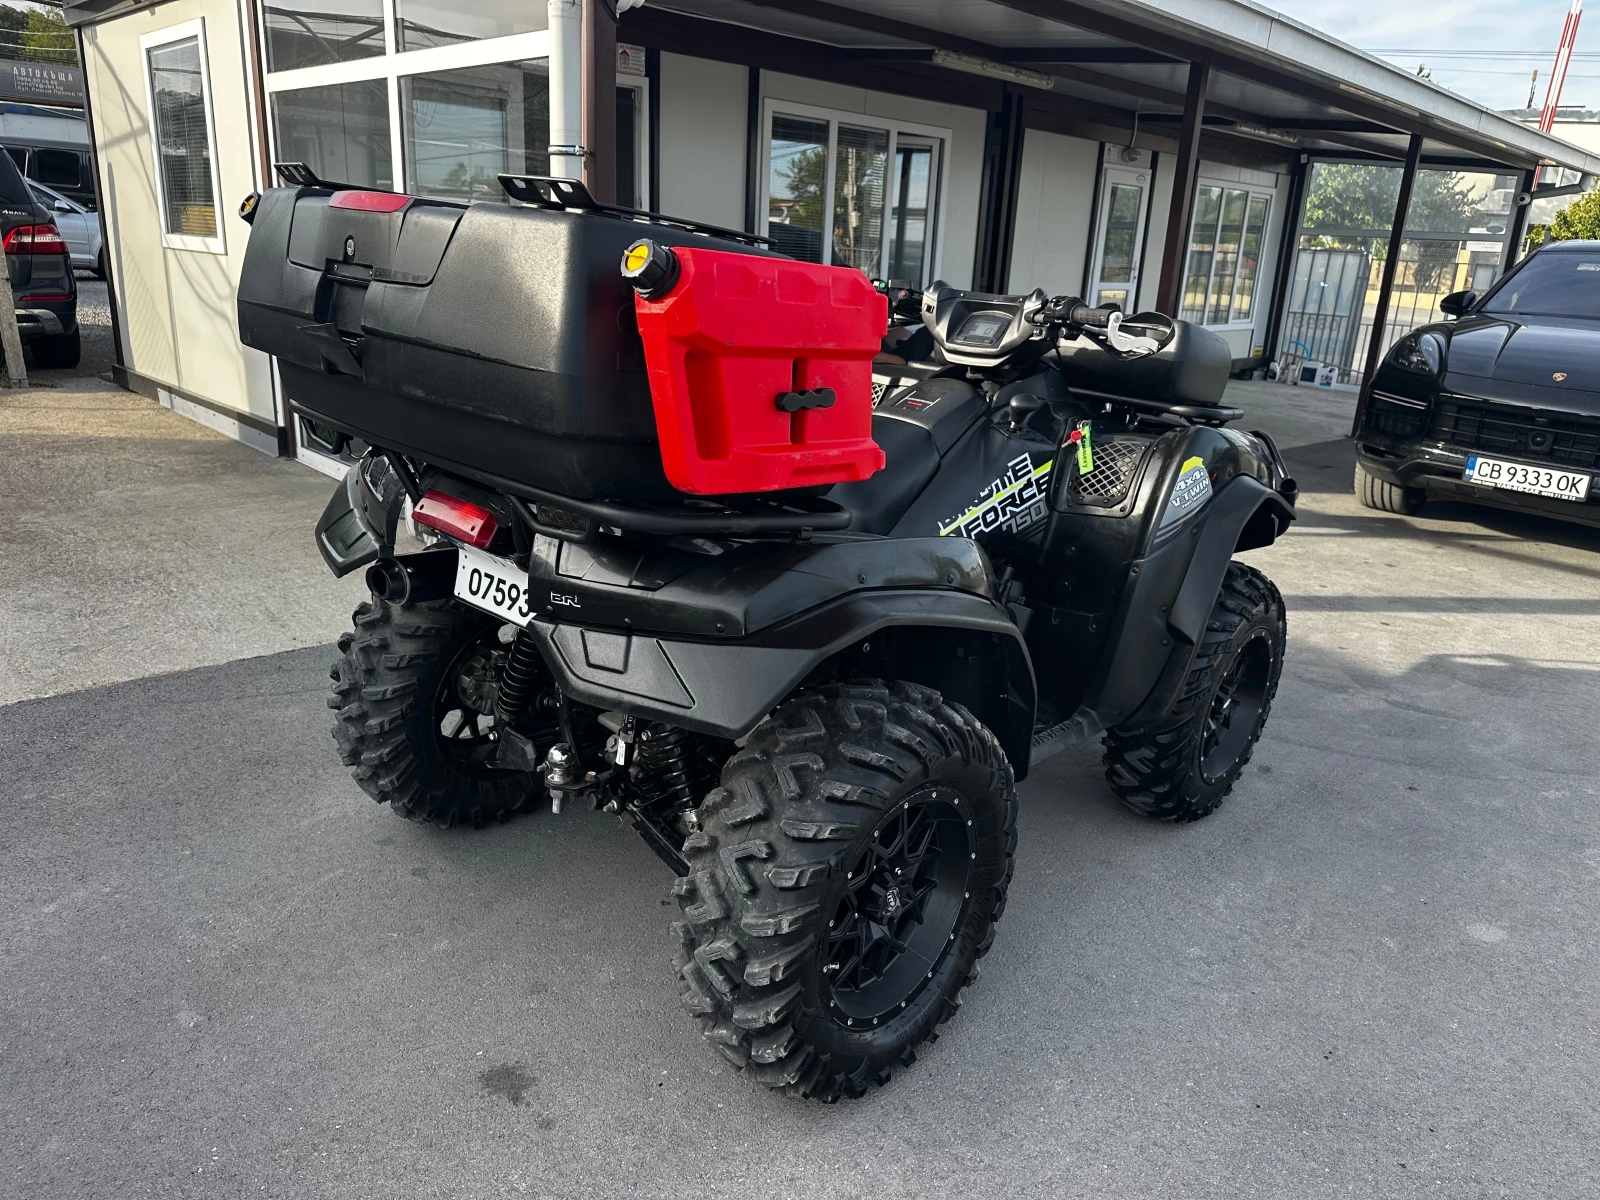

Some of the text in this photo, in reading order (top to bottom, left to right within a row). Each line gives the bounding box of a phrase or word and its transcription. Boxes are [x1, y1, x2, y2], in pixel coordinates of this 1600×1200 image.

[13, 66, 73, 82] АВТОКЪЩА
[1170, 477, 1210, 507] V-TWIN
[1477, 461, 1585, 495] CB 9333 OK
[960, 472, 1050, 540] FORCE
[1002, 495, 1050, 534] 750
